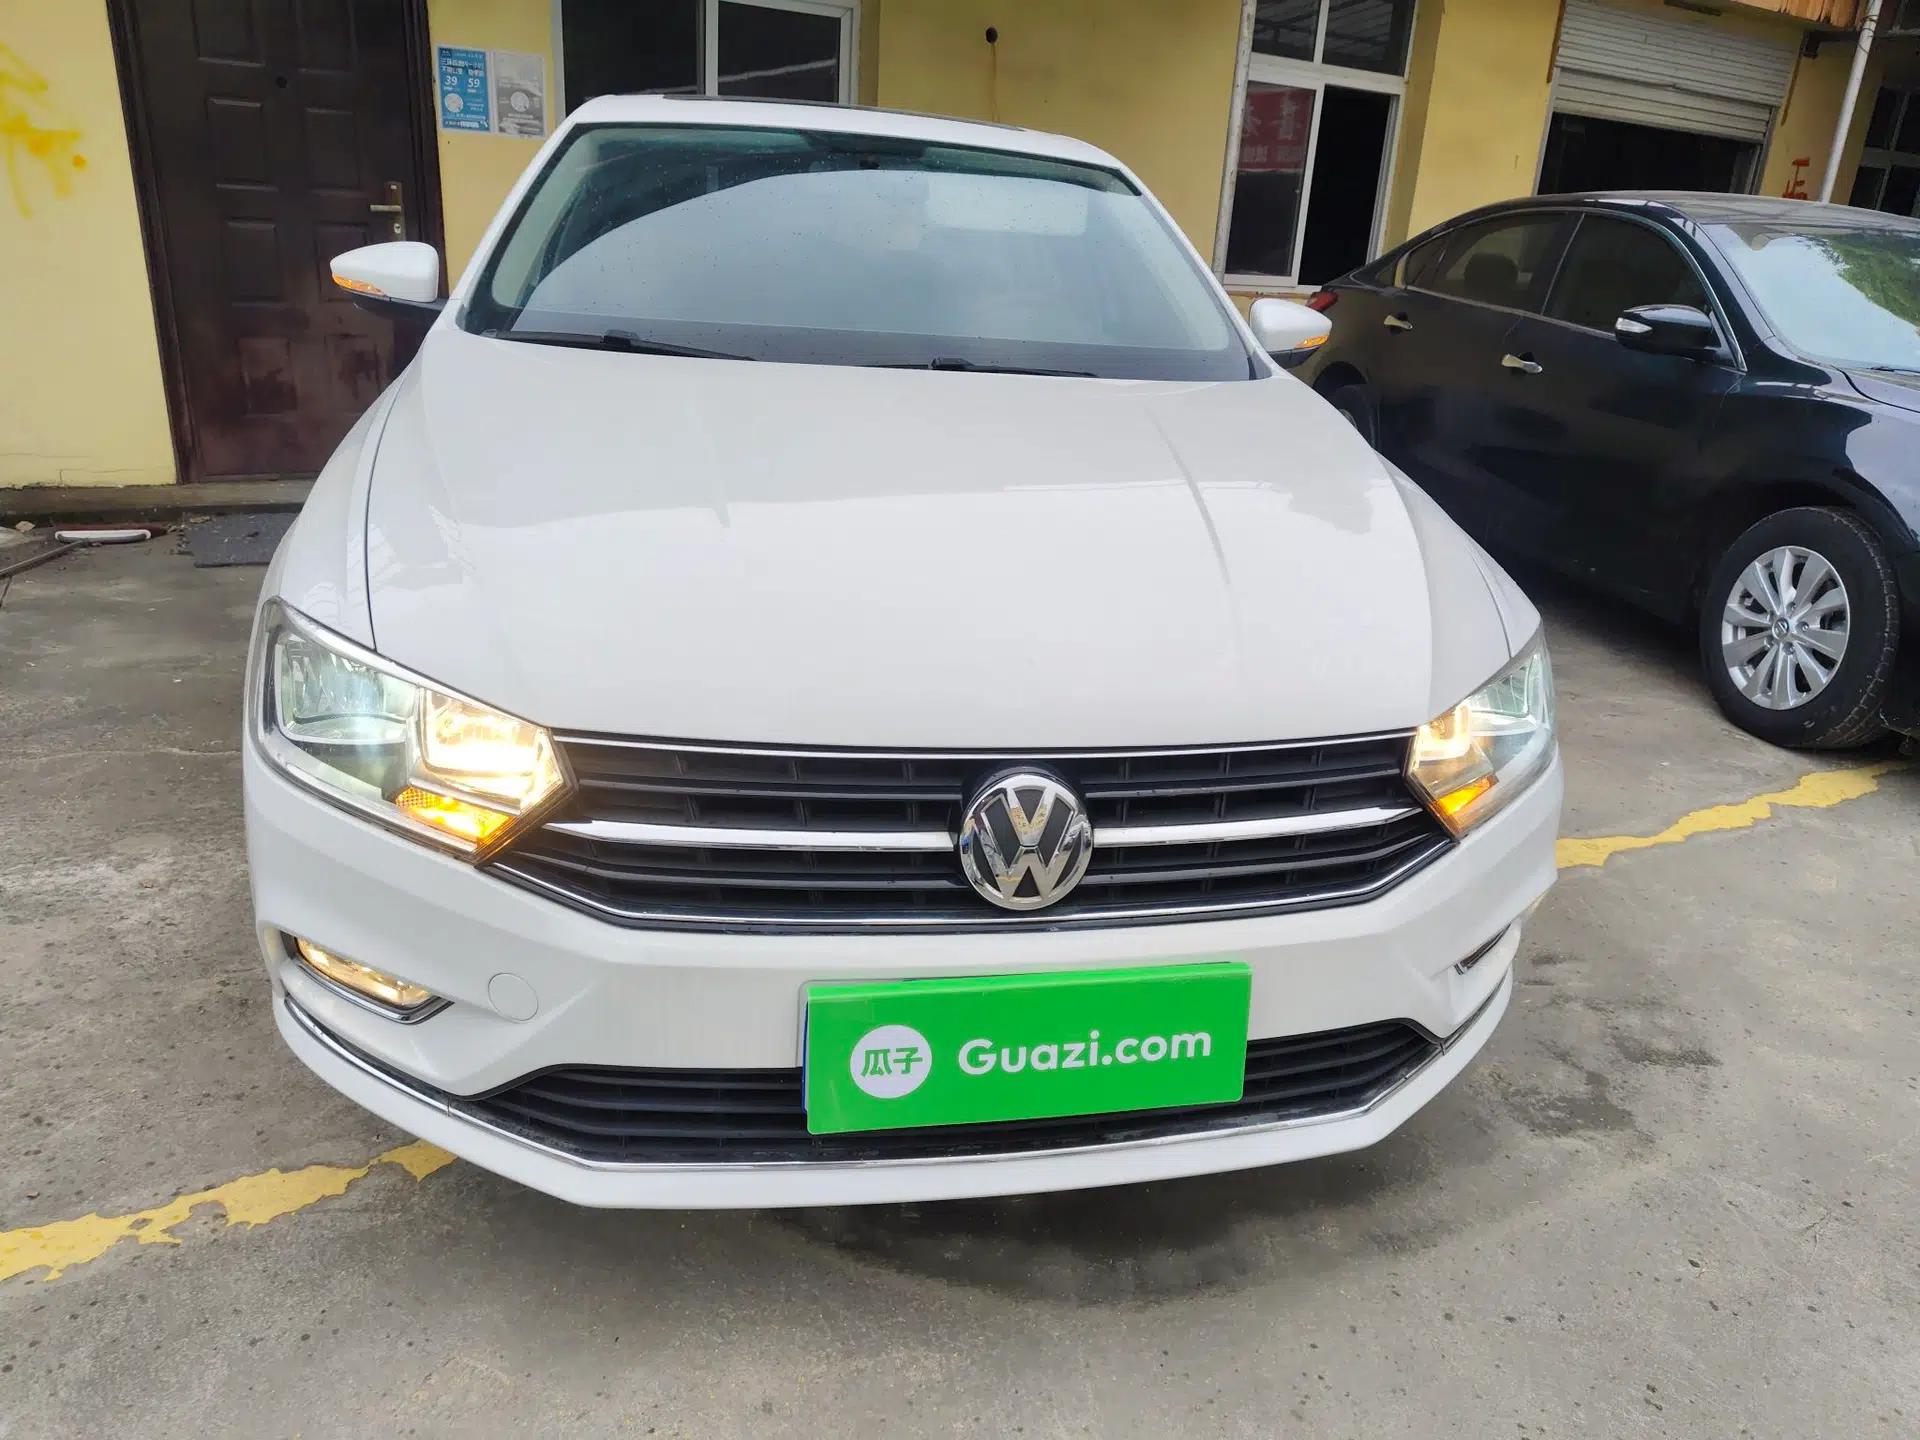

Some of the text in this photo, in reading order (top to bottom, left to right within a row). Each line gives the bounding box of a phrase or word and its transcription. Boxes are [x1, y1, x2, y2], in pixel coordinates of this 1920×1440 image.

[445, 76, 480, 88] 39 59
[861, 1047, 923, 1078] 瓜子
[958, 1030, 1211, 1075] Guazi.com
